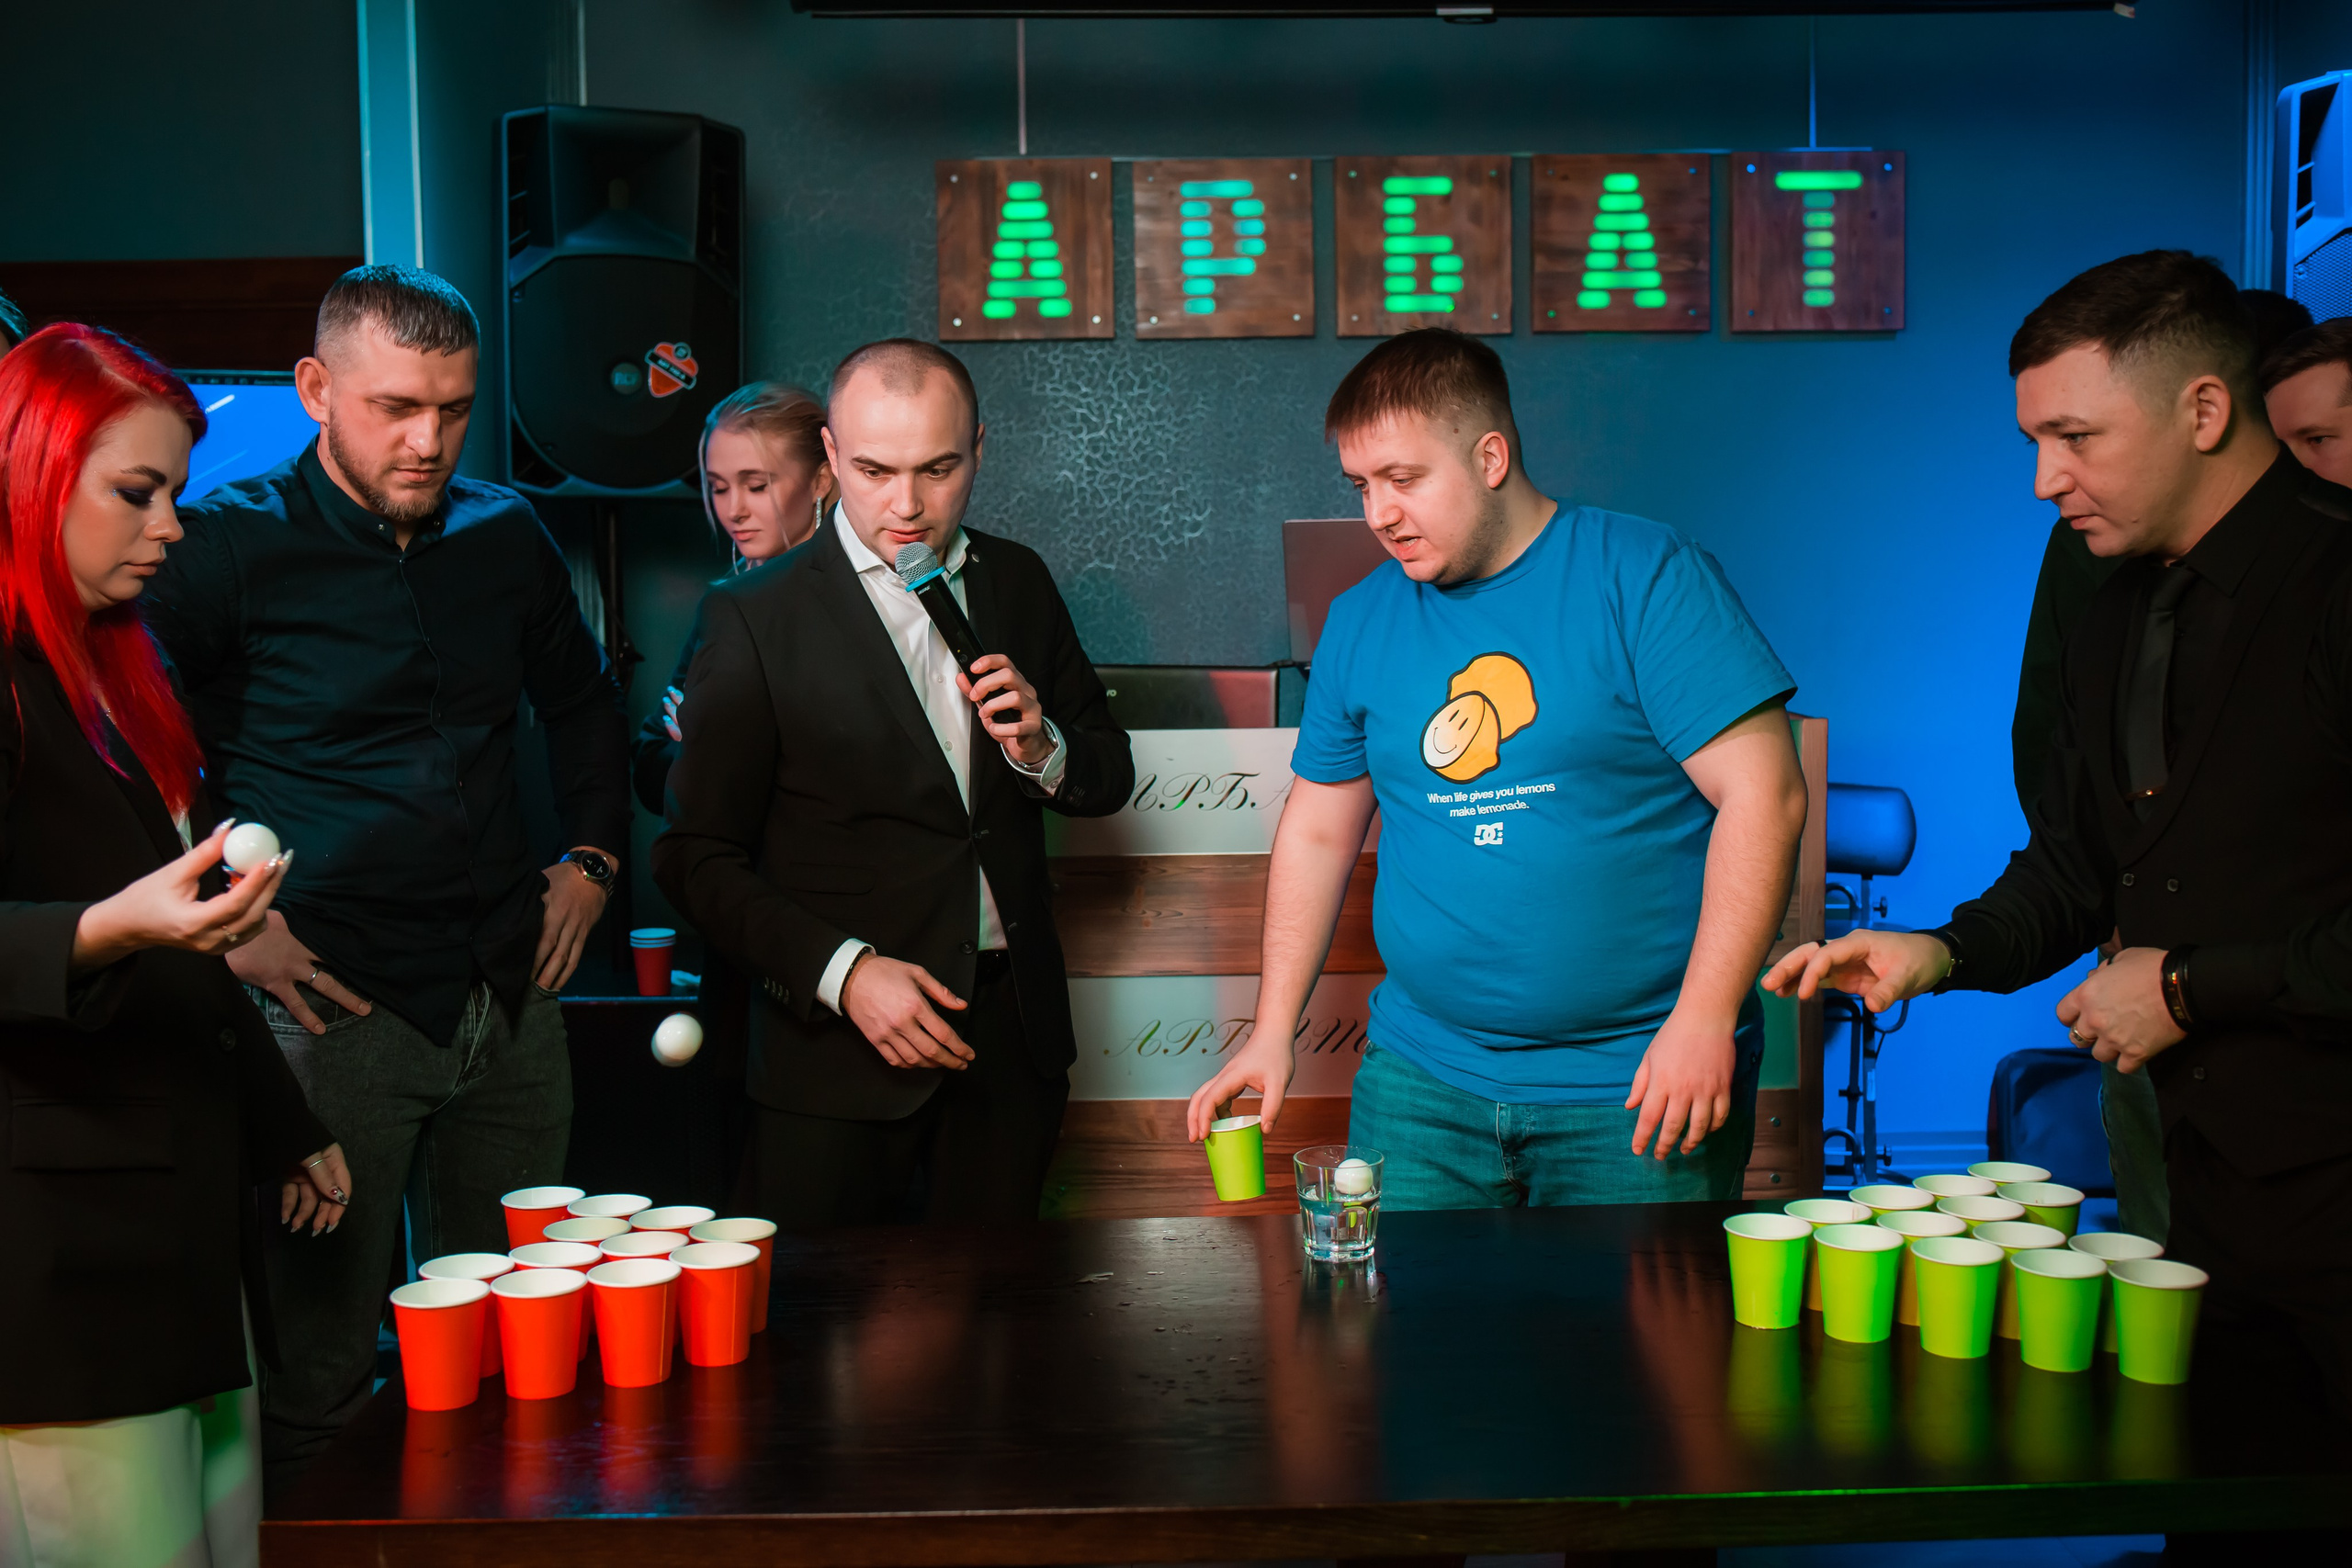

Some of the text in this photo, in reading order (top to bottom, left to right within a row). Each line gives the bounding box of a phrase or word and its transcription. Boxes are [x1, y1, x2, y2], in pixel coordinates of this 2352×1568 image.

[981, 172, 1863, 319] АРБАТ
[1427, 783, 1556, 804] When life gives you lemons
[1449, 799, 1531, 818] make lemonade.
[1473, 821, 1504, 846] DC
